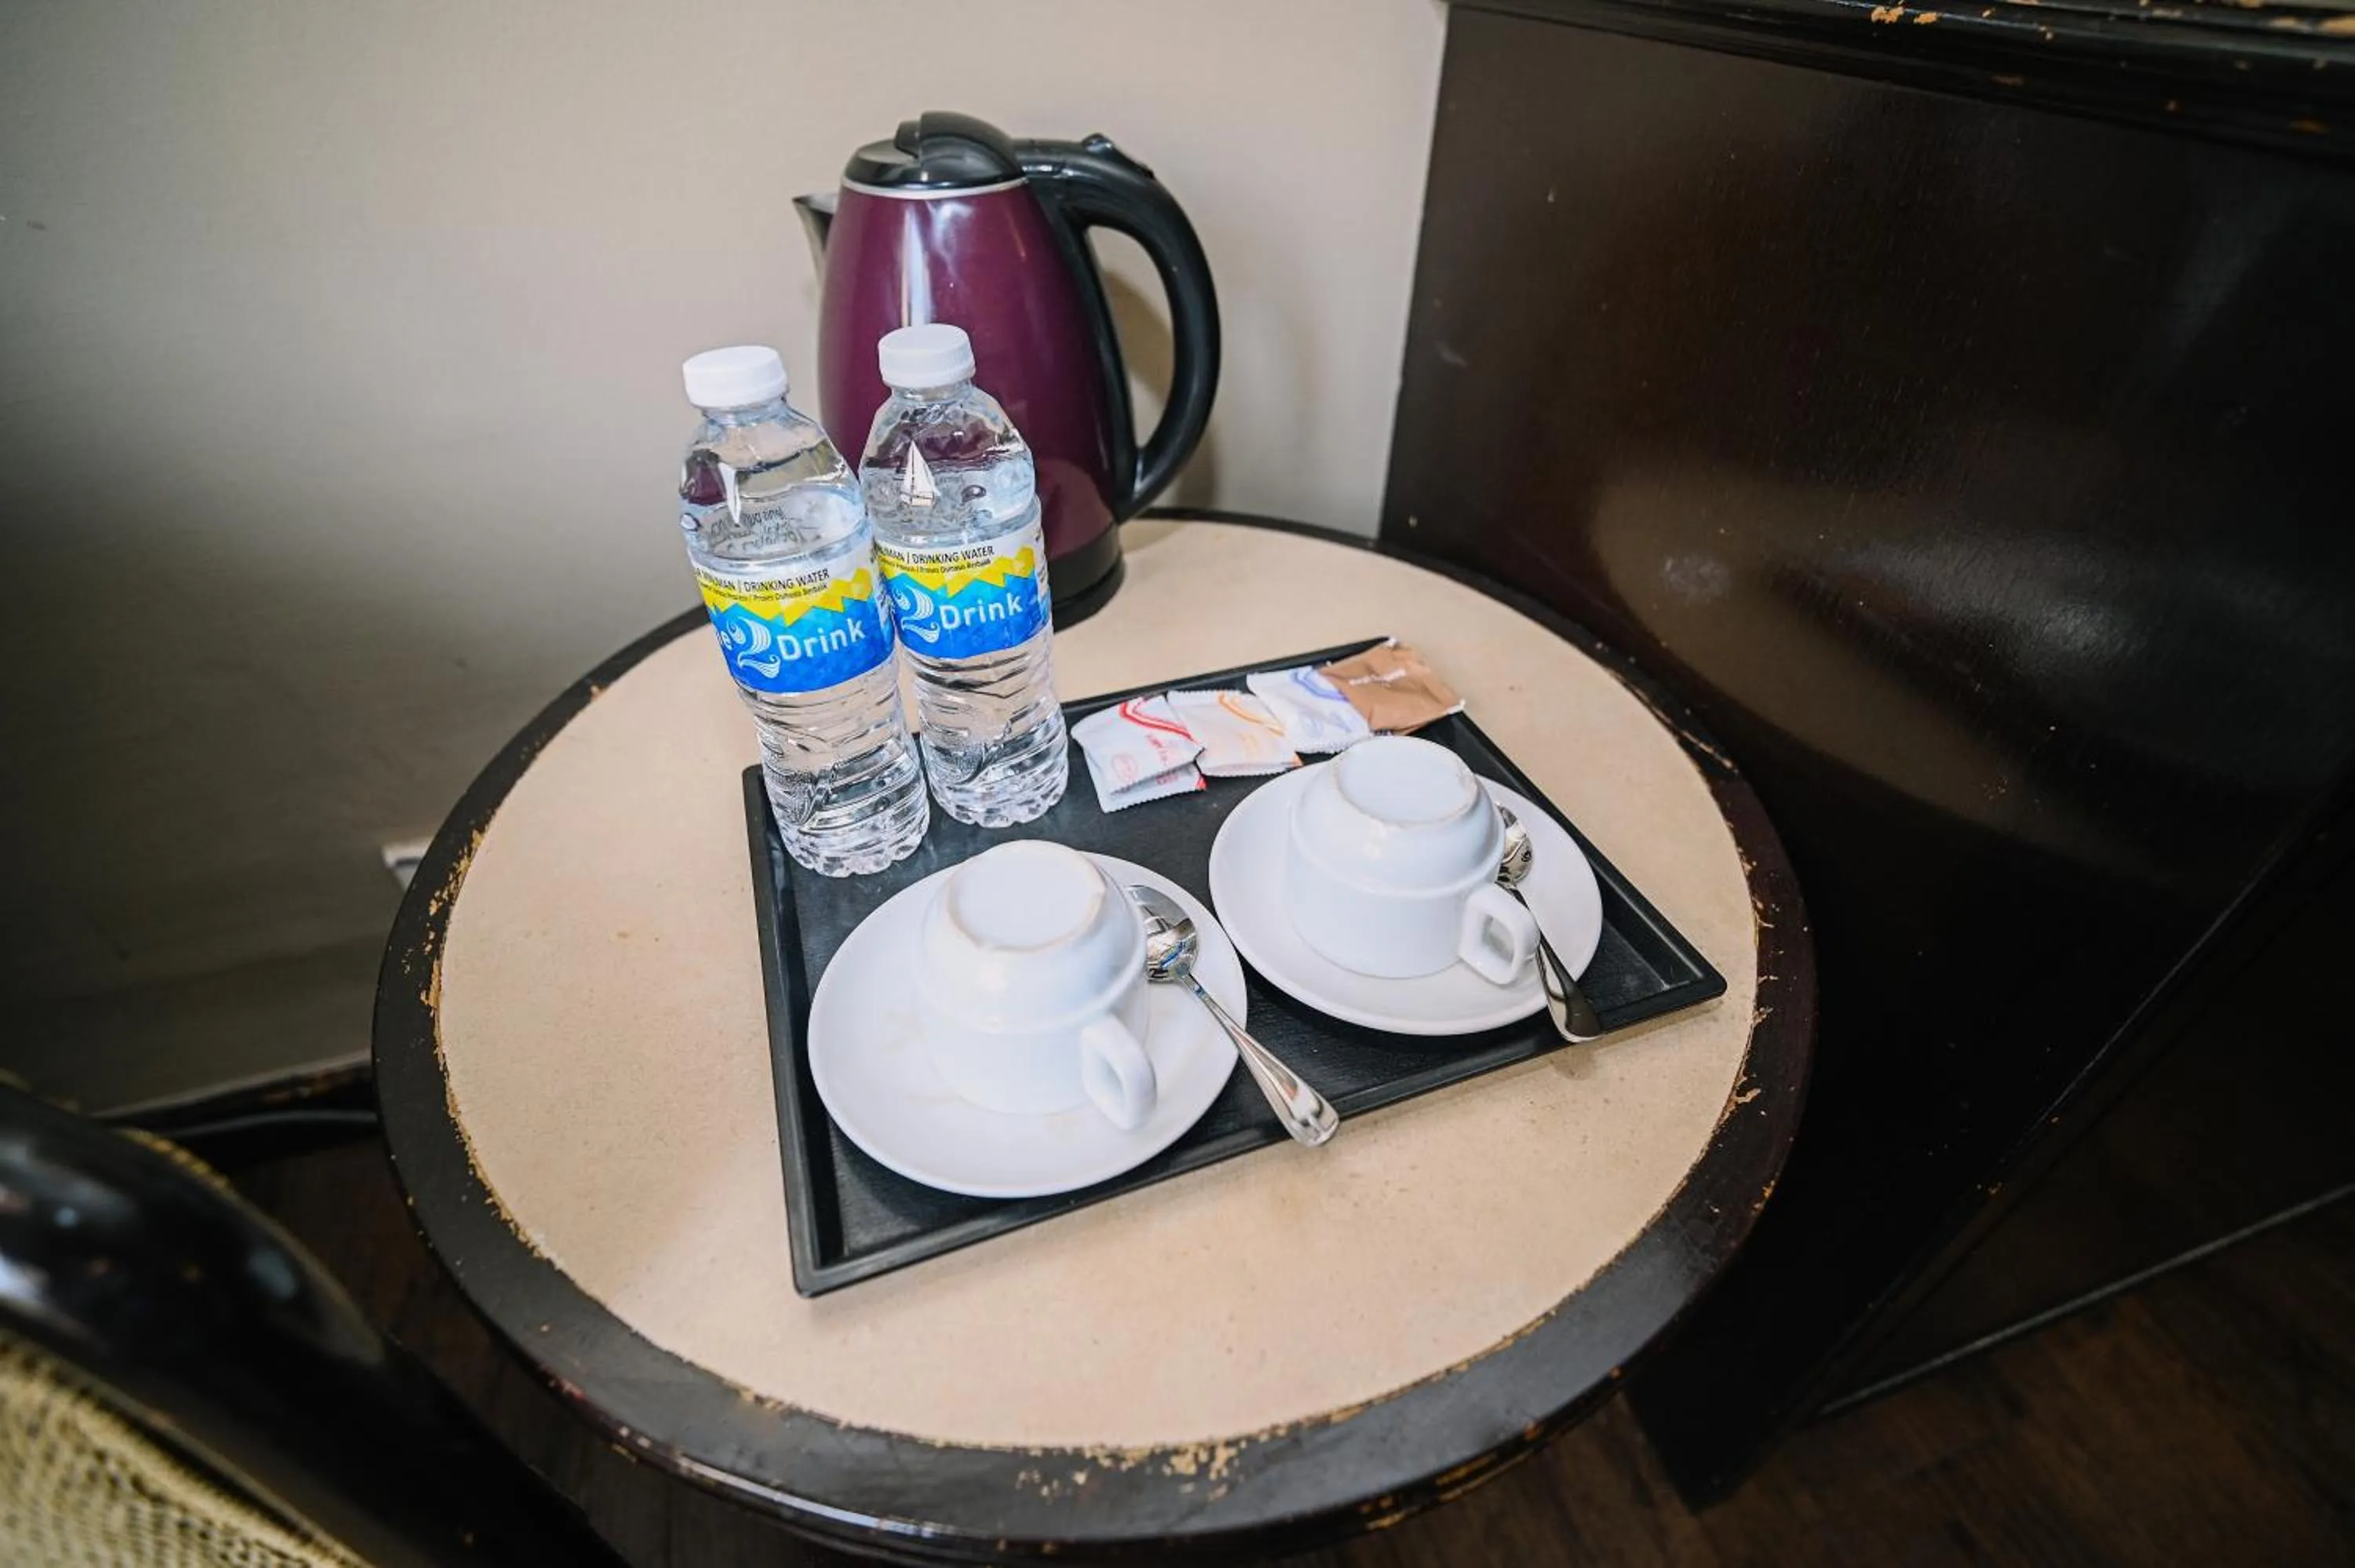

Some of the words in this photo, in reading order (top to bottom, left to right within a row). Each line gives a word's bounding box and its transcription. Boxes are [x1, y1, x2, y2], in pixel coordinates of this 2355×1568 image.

[911, 552, 959, 564] DRINKING
[961, 545, 995, 560] WATER
[743, 578, 794, 593] DRINKING
[795, 568, 830, 587] WATER
[939, 592, 1023, 629] Drink
[776, 618, 865, 661] Drink
